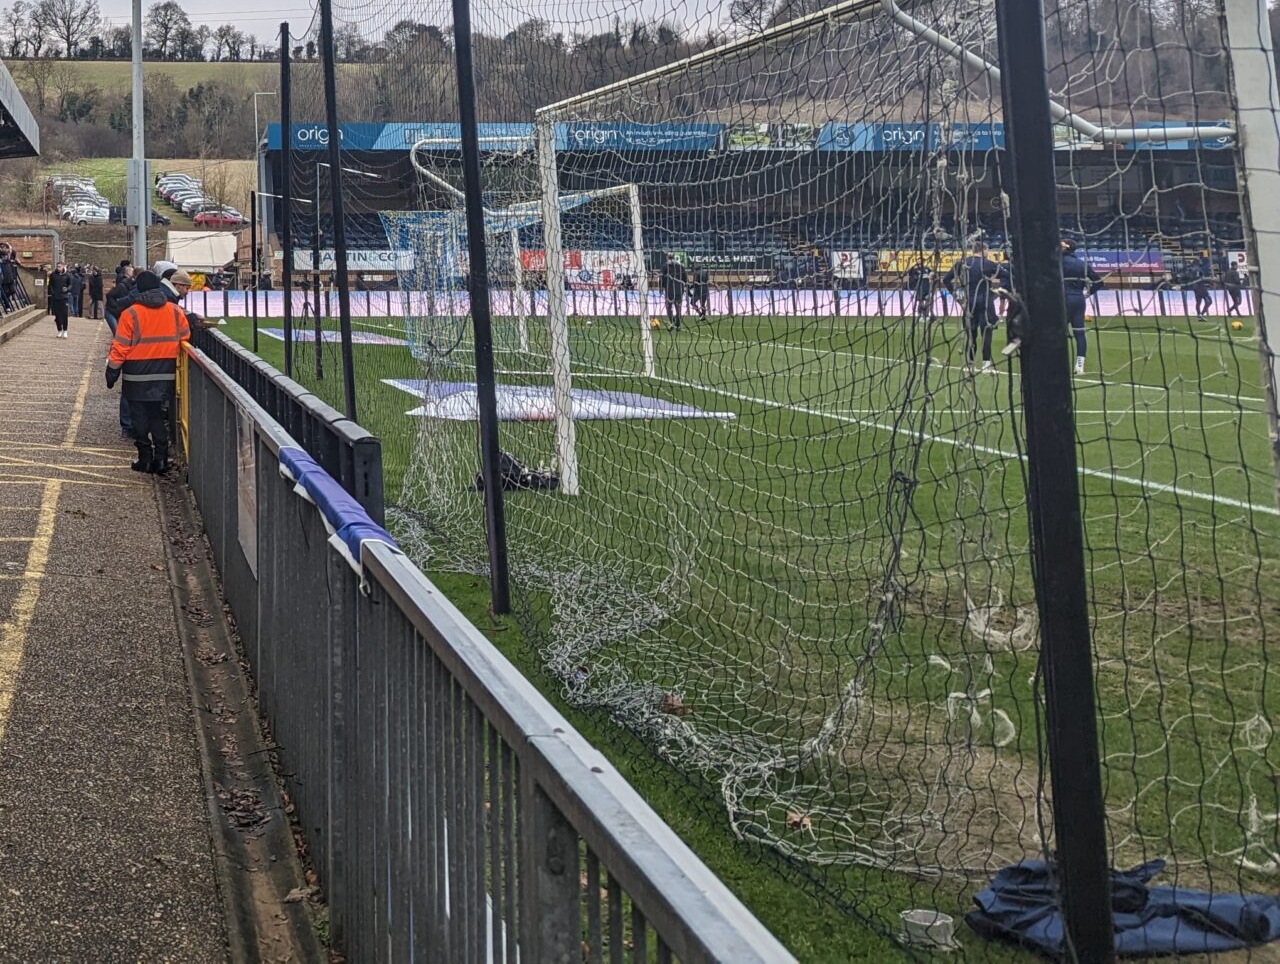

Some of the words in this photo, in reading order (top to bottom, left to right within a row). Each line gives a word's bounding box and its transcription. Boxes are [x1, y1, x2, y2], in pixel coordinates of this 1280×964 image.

[297, 125, 344, 145] orign
[575, 127, 618, 144] origin
[882, 127, 926, 145] origin
